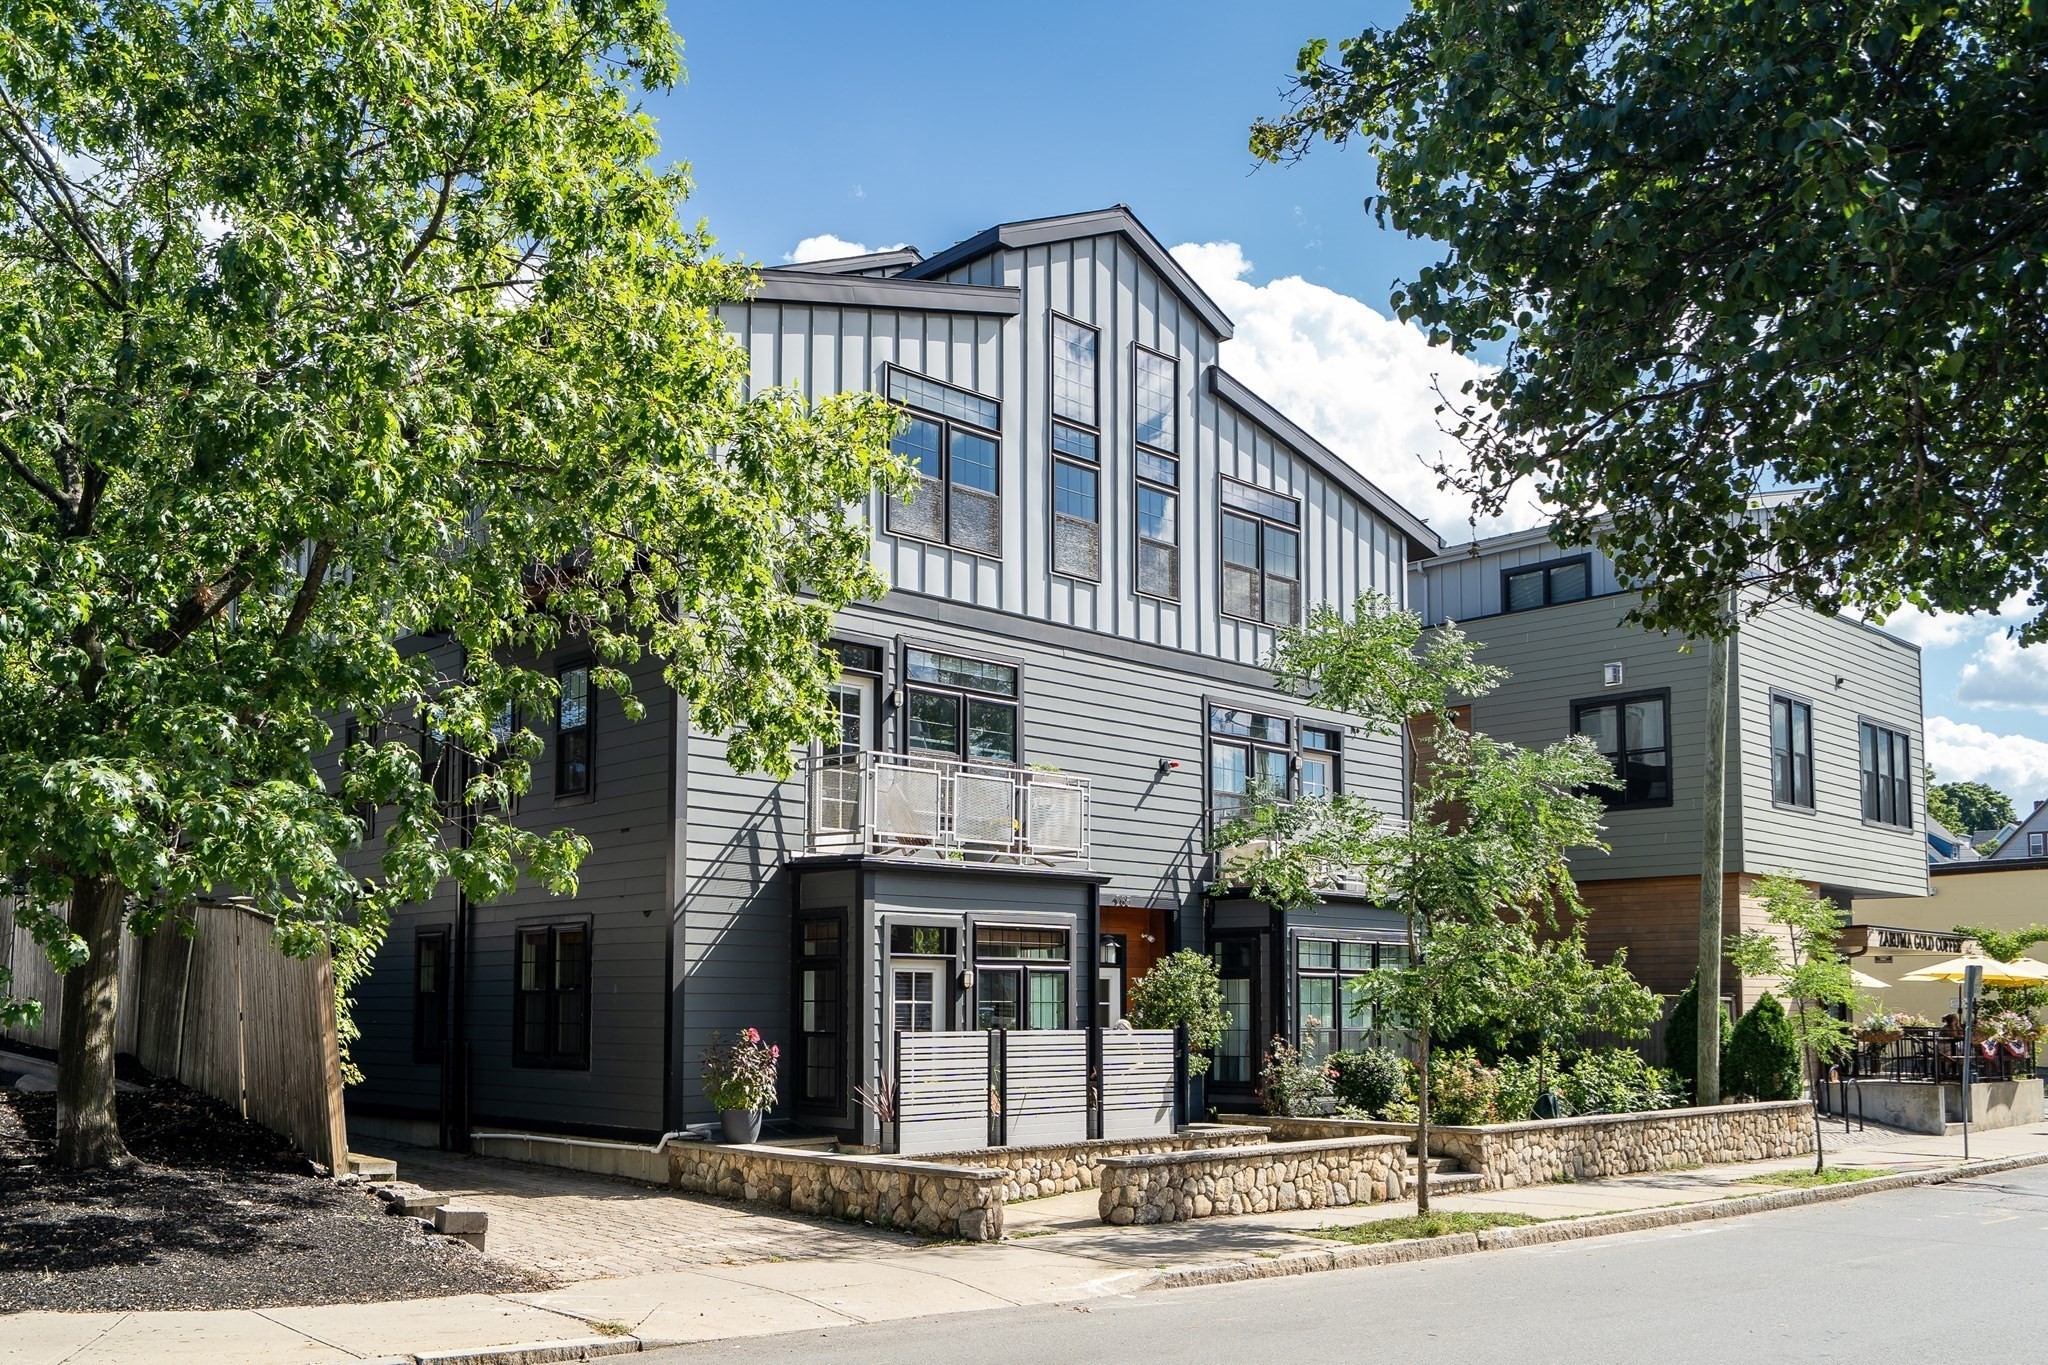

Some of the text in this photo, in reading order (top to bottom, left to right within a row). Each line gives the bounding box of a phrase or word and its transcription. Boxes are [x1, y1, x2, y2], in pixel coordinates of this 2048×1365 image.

[1878, 931, 1962, 953] ZARUMA GOLD COFFEE
